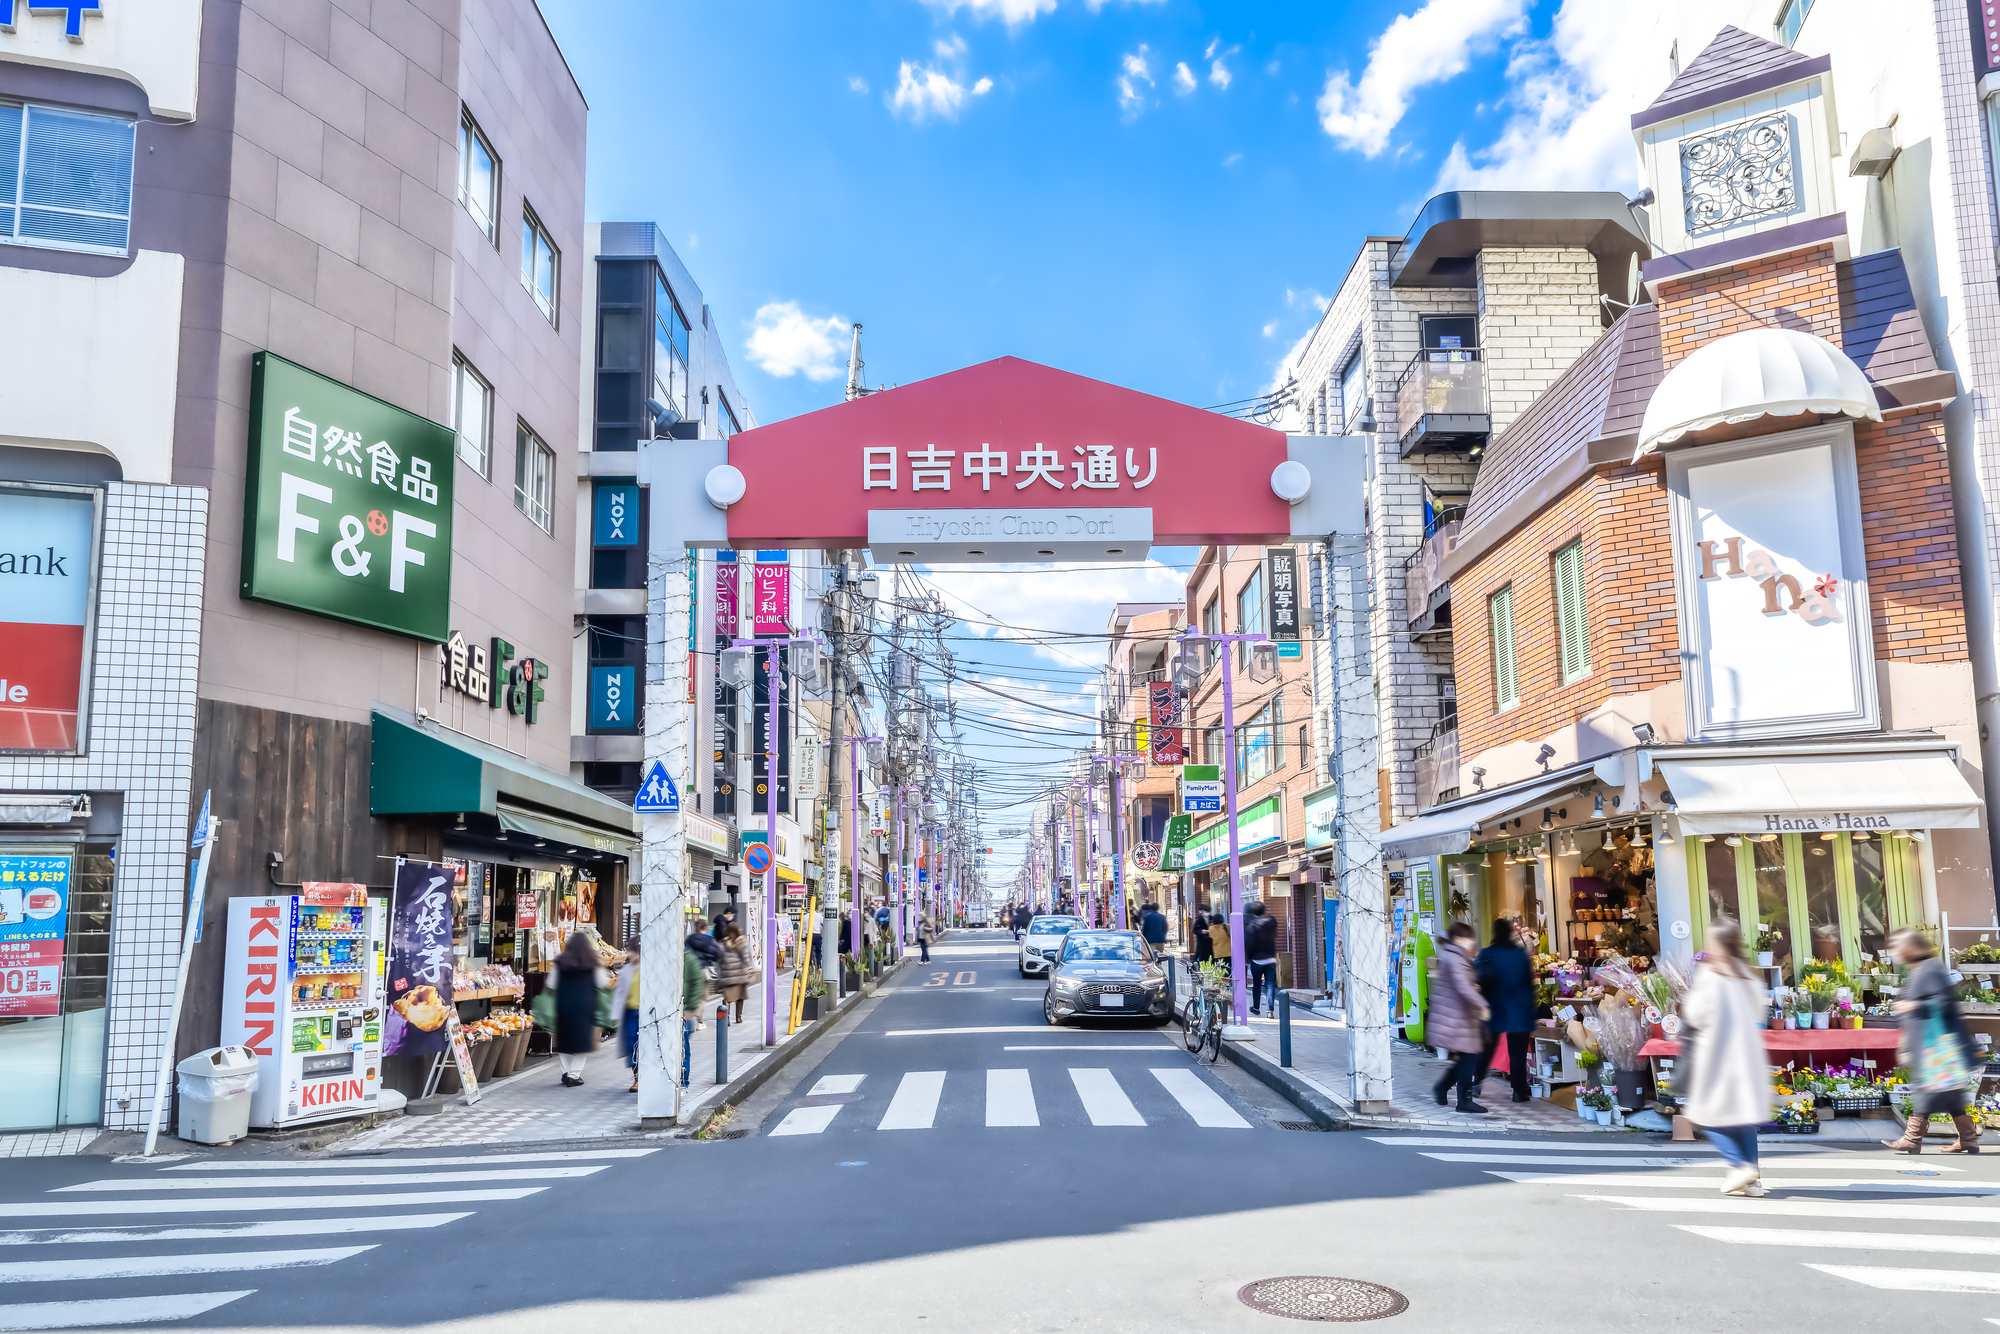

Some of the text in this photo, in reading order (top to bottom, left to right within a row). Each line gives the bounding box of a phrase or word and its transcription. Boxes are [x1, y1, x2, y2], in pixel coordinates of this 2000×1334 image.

[283, 406, 438, 506] 自然食品
[863, 443, 1157, 491] 日吉中央通り
[610, 493, 625, 538] NOVA
[905, 514, 1116, 540] Hiyoshi Chuo Dori
[277, 472, 437, 594] F&F
[756, 567, 783, 578] YOU
[761, 579, 777, 613] ヒフ科
[1273, 556, 1294, 626] 証明写真
[755, 615, 782, 623] CLINIC
[440, 630, 489, 702] 食品
[606, 673, 621, 721] NOVA
[1152, 687, 1174, 753] ラーメン
[807, 749, 815, 779] ひよしの丘
[1155, 753, 1180, 762] 壱角家
[1189, 801, 1197, 809] 酒
[1763, 813, 1890, 831] Hana Hana
[4, 932, 58, 940] LINEもそのまま
[26, 981, 52, 992] 還元
[244, 906, 281, 1056] KIRIN
[923, 971, 977, 987] 30
[302, 1078, 364, 1108] KIRIN
